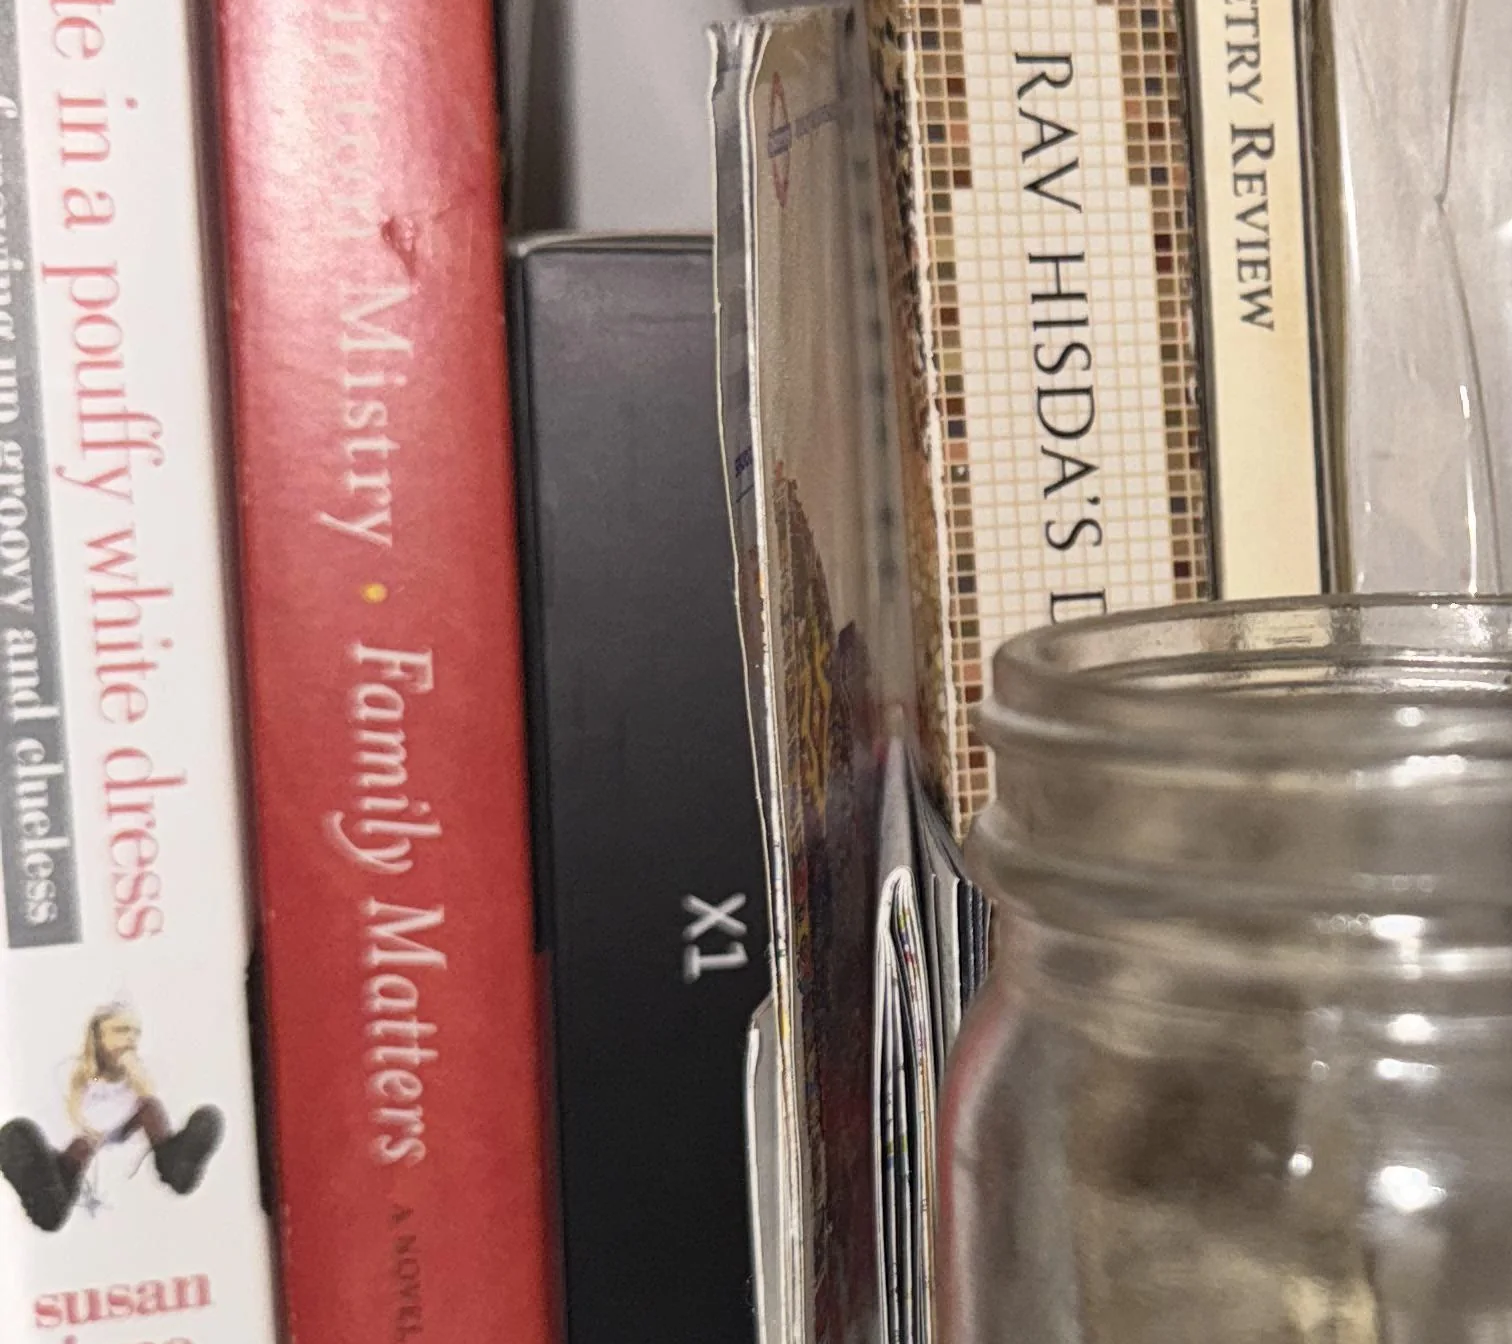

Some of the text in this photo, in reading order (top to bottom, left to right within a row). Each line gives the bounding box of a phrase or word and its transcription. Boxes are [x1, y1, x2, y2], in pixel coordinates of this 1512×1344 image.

[55, 92, 138, 166] in
[62, 187, 115, 230] a
[1014, 51, 1082, 214] RAV
[1230, 123, 1276, 332] REVIEW
[41, 260, 164, 504] pouffy
[316, 281, 413, 549] Mistry
[1027, 252, 1104, 552] HISDA'S
[4, 629, 61, 723] and
[86, 527, 174, 725] white
[16, 738, 72, 927] clueless
[102, 747, 188, 942] dress
[321, 642, 447, 1166] Family Matters
[34, 1273, 212, 1331] susan
[394, 1234, 424, 1344] NOVEL
